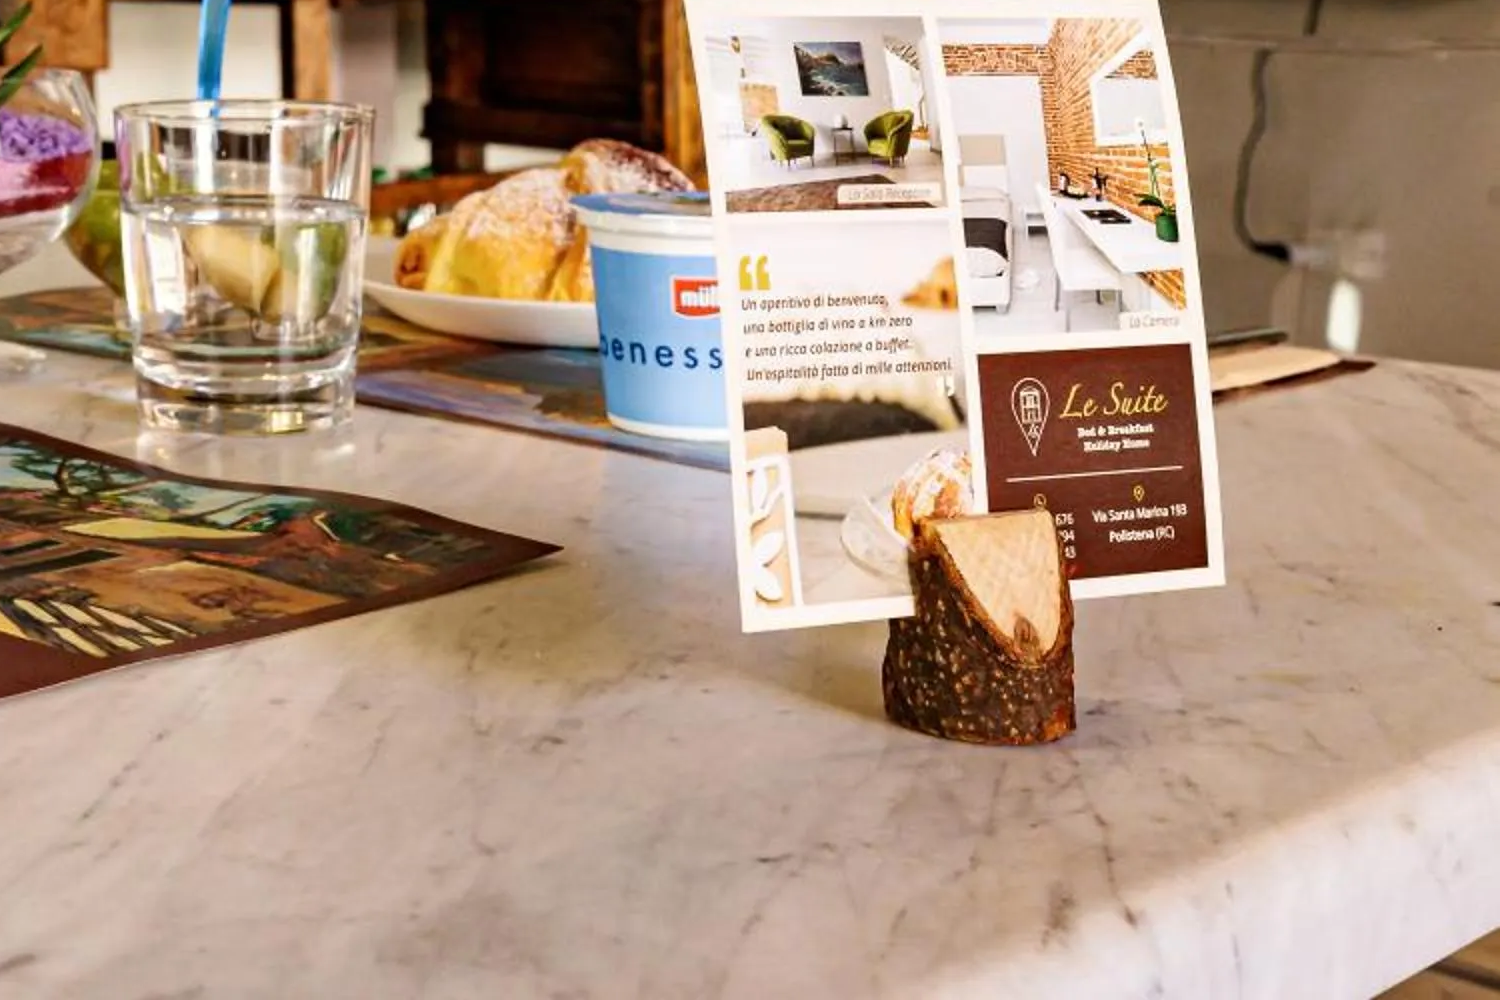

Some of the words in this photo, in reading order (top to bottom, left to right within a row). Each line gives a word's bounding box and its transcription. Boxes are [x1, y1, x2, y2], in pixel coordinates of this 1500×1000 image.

[741, 298, 757, 311] Un
[760, 296, 811, 312] aperitivo
[813, 294, 824, 307] di
[743, 322, 765, 334] una
[768, 319, 815, 335] bottiglia
[831, 317, 856, 330] vino
[889, 316, 913, 327] zero
[779, 343, 807, 356] ricca
[809, 340, 863, 355] colazione
[865, 341, 873, 352] a
[820, 363, 849, 381] fatta
[851, 361, 863, 375] di
[865, 360, 893, 375] mille
[1060, 383, 1099, 418] Le
[1104, 381, 1169, 416] Suite
[1097, 424, 1107, 437] &
[1107, 423, 1154, 436] Breakfast
[1092, 509, 1108, 523] Via
[1108, 508, 1135, 522] Santa
[1136, 505, 1169, 519] Marina
[1109, 529, 1155, 543] Polistena
